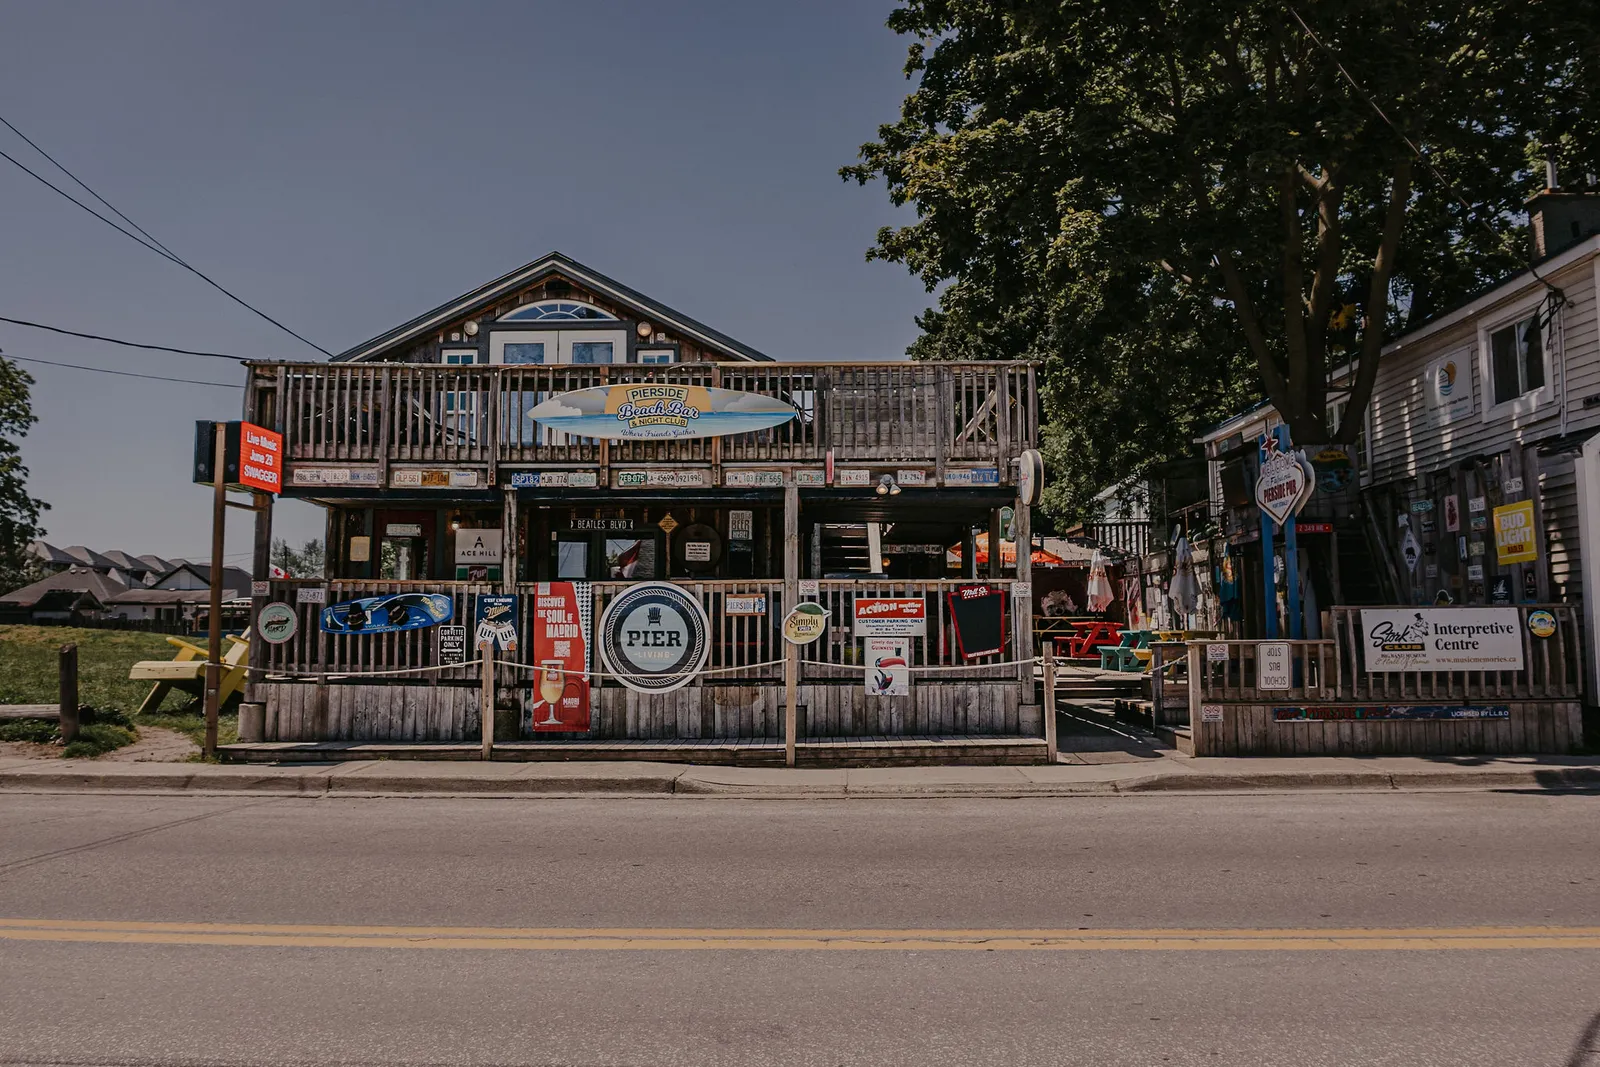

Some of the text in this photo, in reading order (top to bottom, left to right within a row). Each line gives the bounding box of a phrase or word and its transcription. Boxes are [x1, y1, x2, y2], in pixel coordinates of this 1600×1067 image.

[632, 387, 684, 400] PIERSIDE
[619, 400, 700, 419] Beach Bar
[639, 417, 663, 426] NIGHT
[664, 418, 686, 427] CLUB
[620, 428, 696, 438] Where Friends Gather
[246, 431, 277, 451] Live Music
[250, 449, 265, 464] June
[244, 465, 278, 483] SWAGGER
[1263, 479, 1297, 504] PIERSIDE PUB
[577, 520, 627, 529] BEATLES BLVD
[731, 520, 750, 531] BEER
[1501, 513, 1526, 531] BUD
[1498, 527, 1533, 547] LIGHT
[537, 598, 565, 608] DISCOVER
[858, 601, 898, 616] ACTION
[537, 609, 546, 618] THE
[546, 609, 567, 623] SOUL
[789, 615, 819, 631] Simply
[479, 628, 496, 638] Lite
[499, 629, 514, 641] Lite
[546, 624, 578, 638] MADRID
[1370, 620, 1413, 648] Stork
[1434, 621, 1514, 640] Interpretive
[626, 631, 682, 647] PIER
[1435, 637, 1480, 651] Centre
[1266, 647, 1282, 657] STOP
[1268, 661, 1281, 672] BUS
[1436, 656, 1517, 664] www.musicmemories.ca
[1263, 676, 1287, 686] SCHOOL
